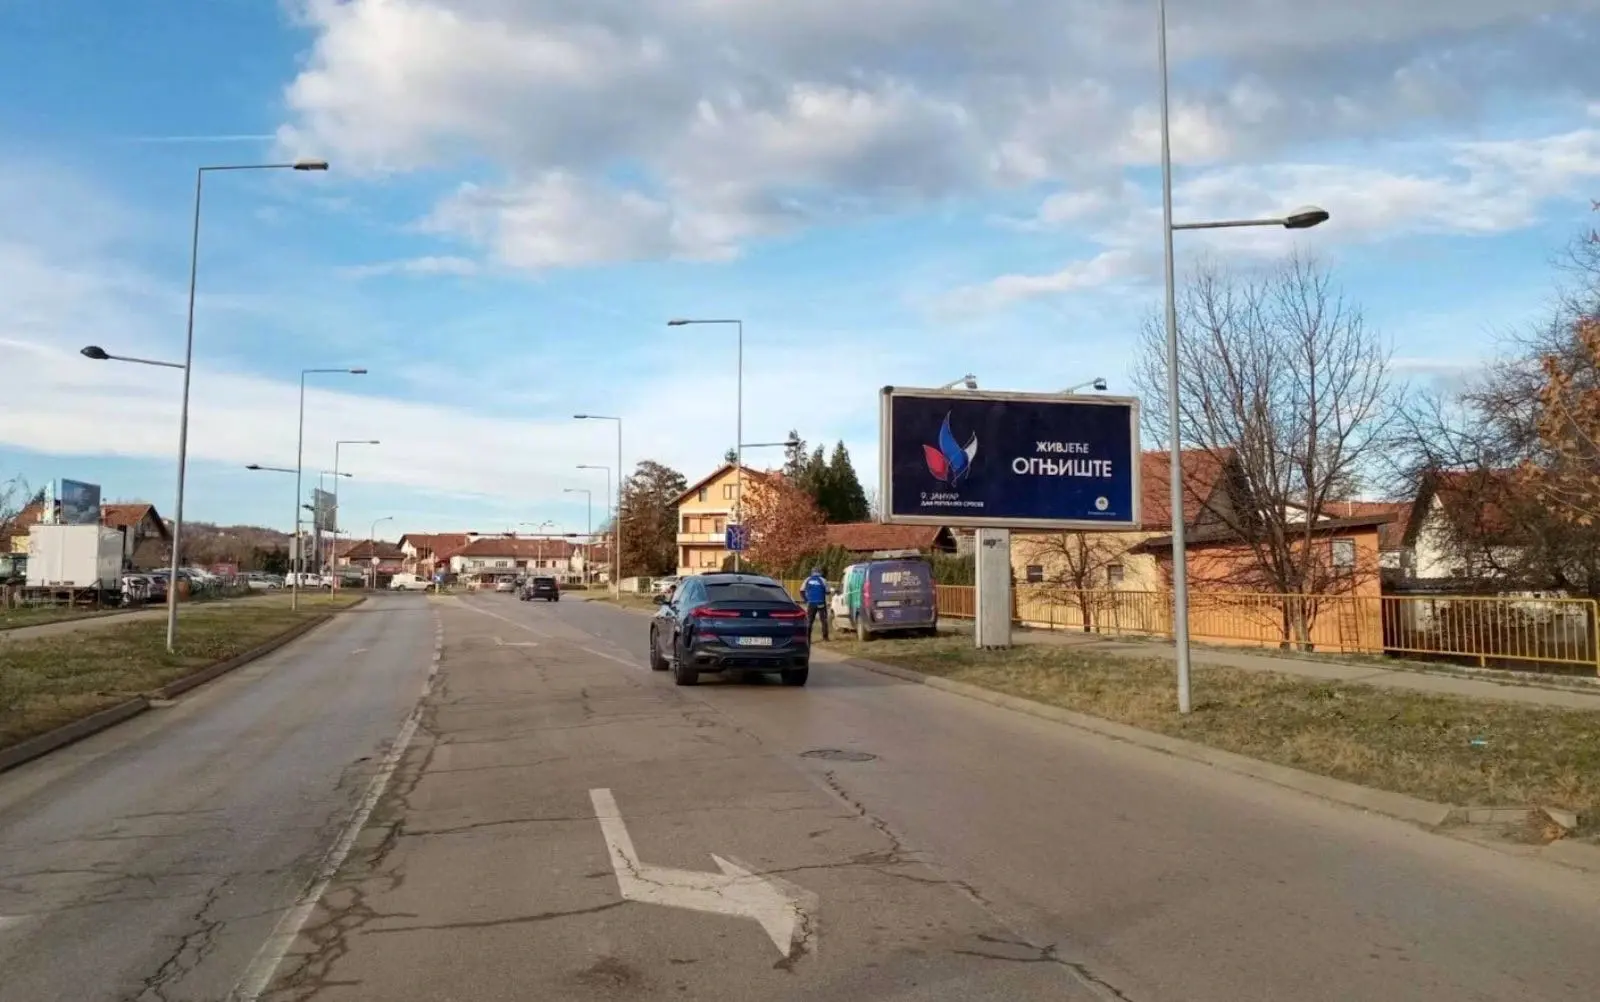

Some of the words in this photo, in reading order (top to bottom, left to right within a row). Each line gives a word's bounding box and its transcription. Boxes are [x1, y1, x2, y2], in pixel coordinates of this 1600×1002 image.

[1036, 441, 1089, 453] ЖИВЈЕЋЕ
[1012, 457, 1112, 477] ОГЊИШТЕ
[930, 492, 959, 500] ЈАНУАР
